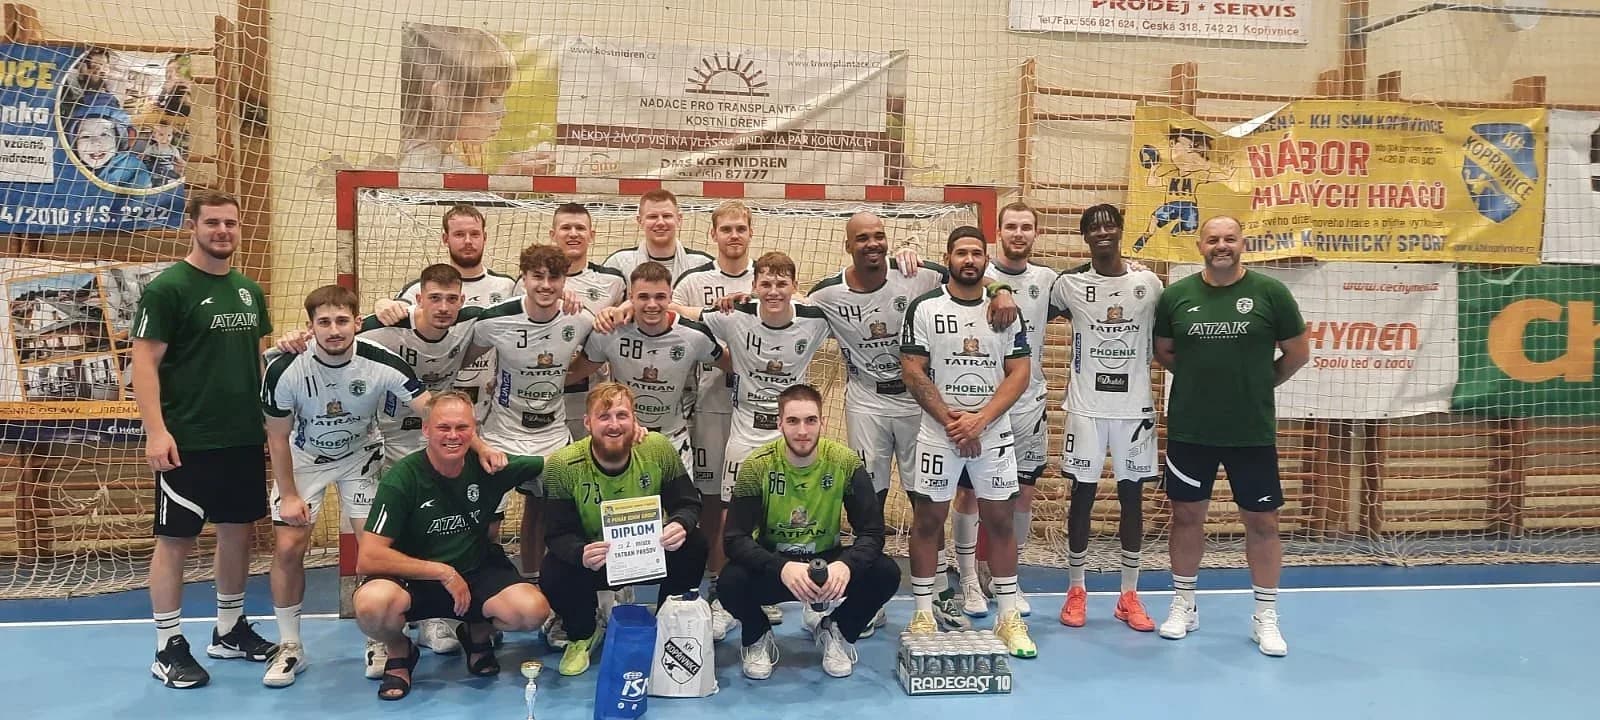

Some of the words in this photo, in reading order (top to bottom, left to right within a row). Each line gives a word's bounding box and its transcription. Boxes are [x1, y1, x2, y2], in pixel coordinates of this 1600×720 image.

[1093, 0, 1190, 15] PRODEJ
[1213, 3, 1296, 17] SERVIS
[1080, 18, 1096, 26] 556
[1205, 24, 1224, 33] 742
[1226, 24, 1239, 33] 21
[639, 98, 687, 111] NADACE
[690, 101, 714, 111] PRO
[1310, 114, 1331, 129] KH
[696, 157, 788, 169] KOSTNIDREN
[1247, 132, 1370, 178] NÁBOR
[725, 169, 768, 180] 87777
[1396, 231, 1448, 253] SPORT
[1086, 286, 1095, 302] 8
[210, 312, 257, 329] ATAK
[838, 305, 862, 322] 44
[934, 314, 958, 334] 66
[1089, 324, 1140, 333] TATRAN
[1187, 321, 1250, 335] ATAK
[516, 329, 528, 349] 3
[746, 331, 762, 355] 14
[858, 340, 901, 349] TATRA
[399, 344, 418, 367] 18
[619, 337, 644, 360] 28
[1090, 347, 1137, 356] PHOENIX
[944, 358, 998, 367] TATRAN
[1313, 356, 1348, 370] Spolu
[305, 375, 319, 398] 11
[626, 380, 676, 391] TATRAN
[945, 384, 996, 393] PHOENIX
[310, 414, 361, 427] TATRAN
[1065, 433, 1075, 453] 8
[920, 452, 944, 476] 66
[582, 483, 601, 504] 73
[611, 523, 655, 539] DIPLOM
[911, 675, 994, 693] RADEGAST
[995, 675, 1011, 690] 10
